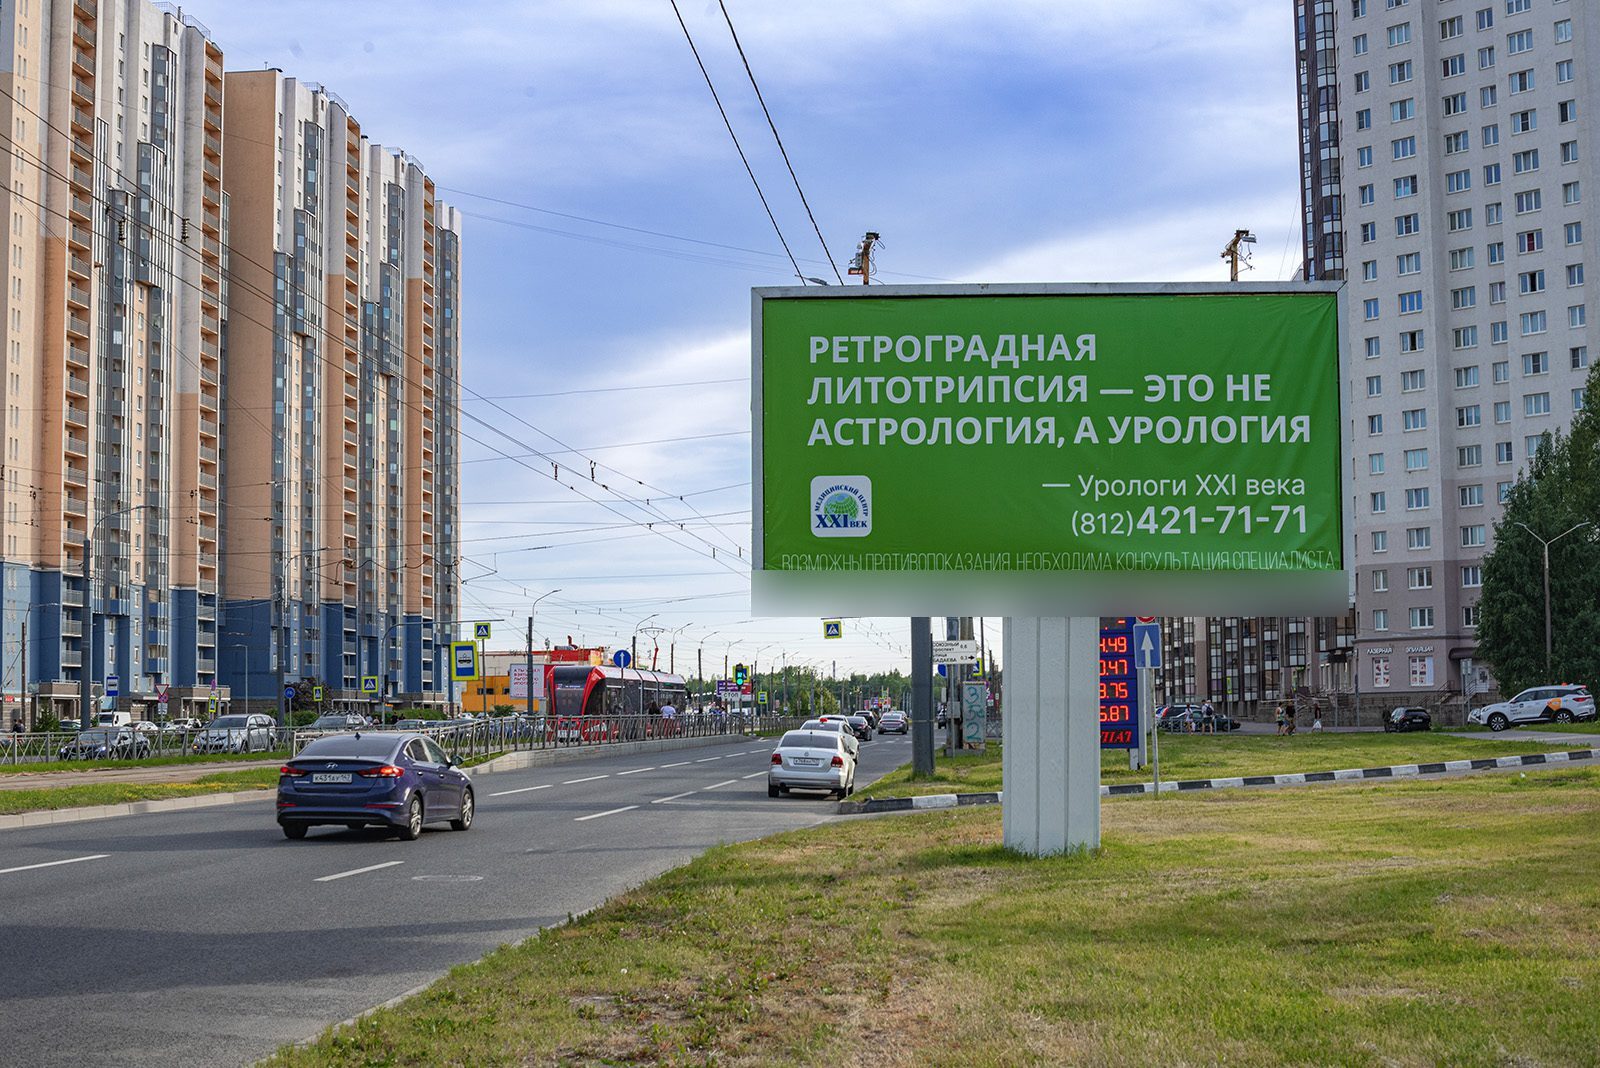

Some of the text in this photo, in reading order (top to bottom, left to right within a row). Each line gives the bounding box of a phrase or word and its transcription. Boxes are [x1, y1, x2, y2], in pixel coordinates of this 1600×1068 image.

[810, 333, 1096, 368] РЕТРОГРАДНАЯ
[807, 374, 1088, 405] ЛИТОТРИПСИЯ
[1144, 374, 1214, 402] ЭТО
[1227, 373, 1271, 402] НЕ
[807, 415, 1310, 449] АСТРОЛОГИЯ, А УРОЛОГИЯ
[815, 484, 859, 512] МЕДИЦИНСКИЙ
[1078, 474, 1187, 500] Урологи
[1196, 473, 1236, 496] XXI
[1246, 478, 1305, 496] века
[815, 514, 868, 528] XXI ВЕК
[782, 553, 862, 570] ВОЗМОЖНЫ
[1016, 551, 1112, 570] НЕОБХОДИМА
[1115, 551, 1230, 571] КОНСУЛЬТАЦИЯ
[1232, 550, 1335, 571] СПЕЦИАЛИСТА
